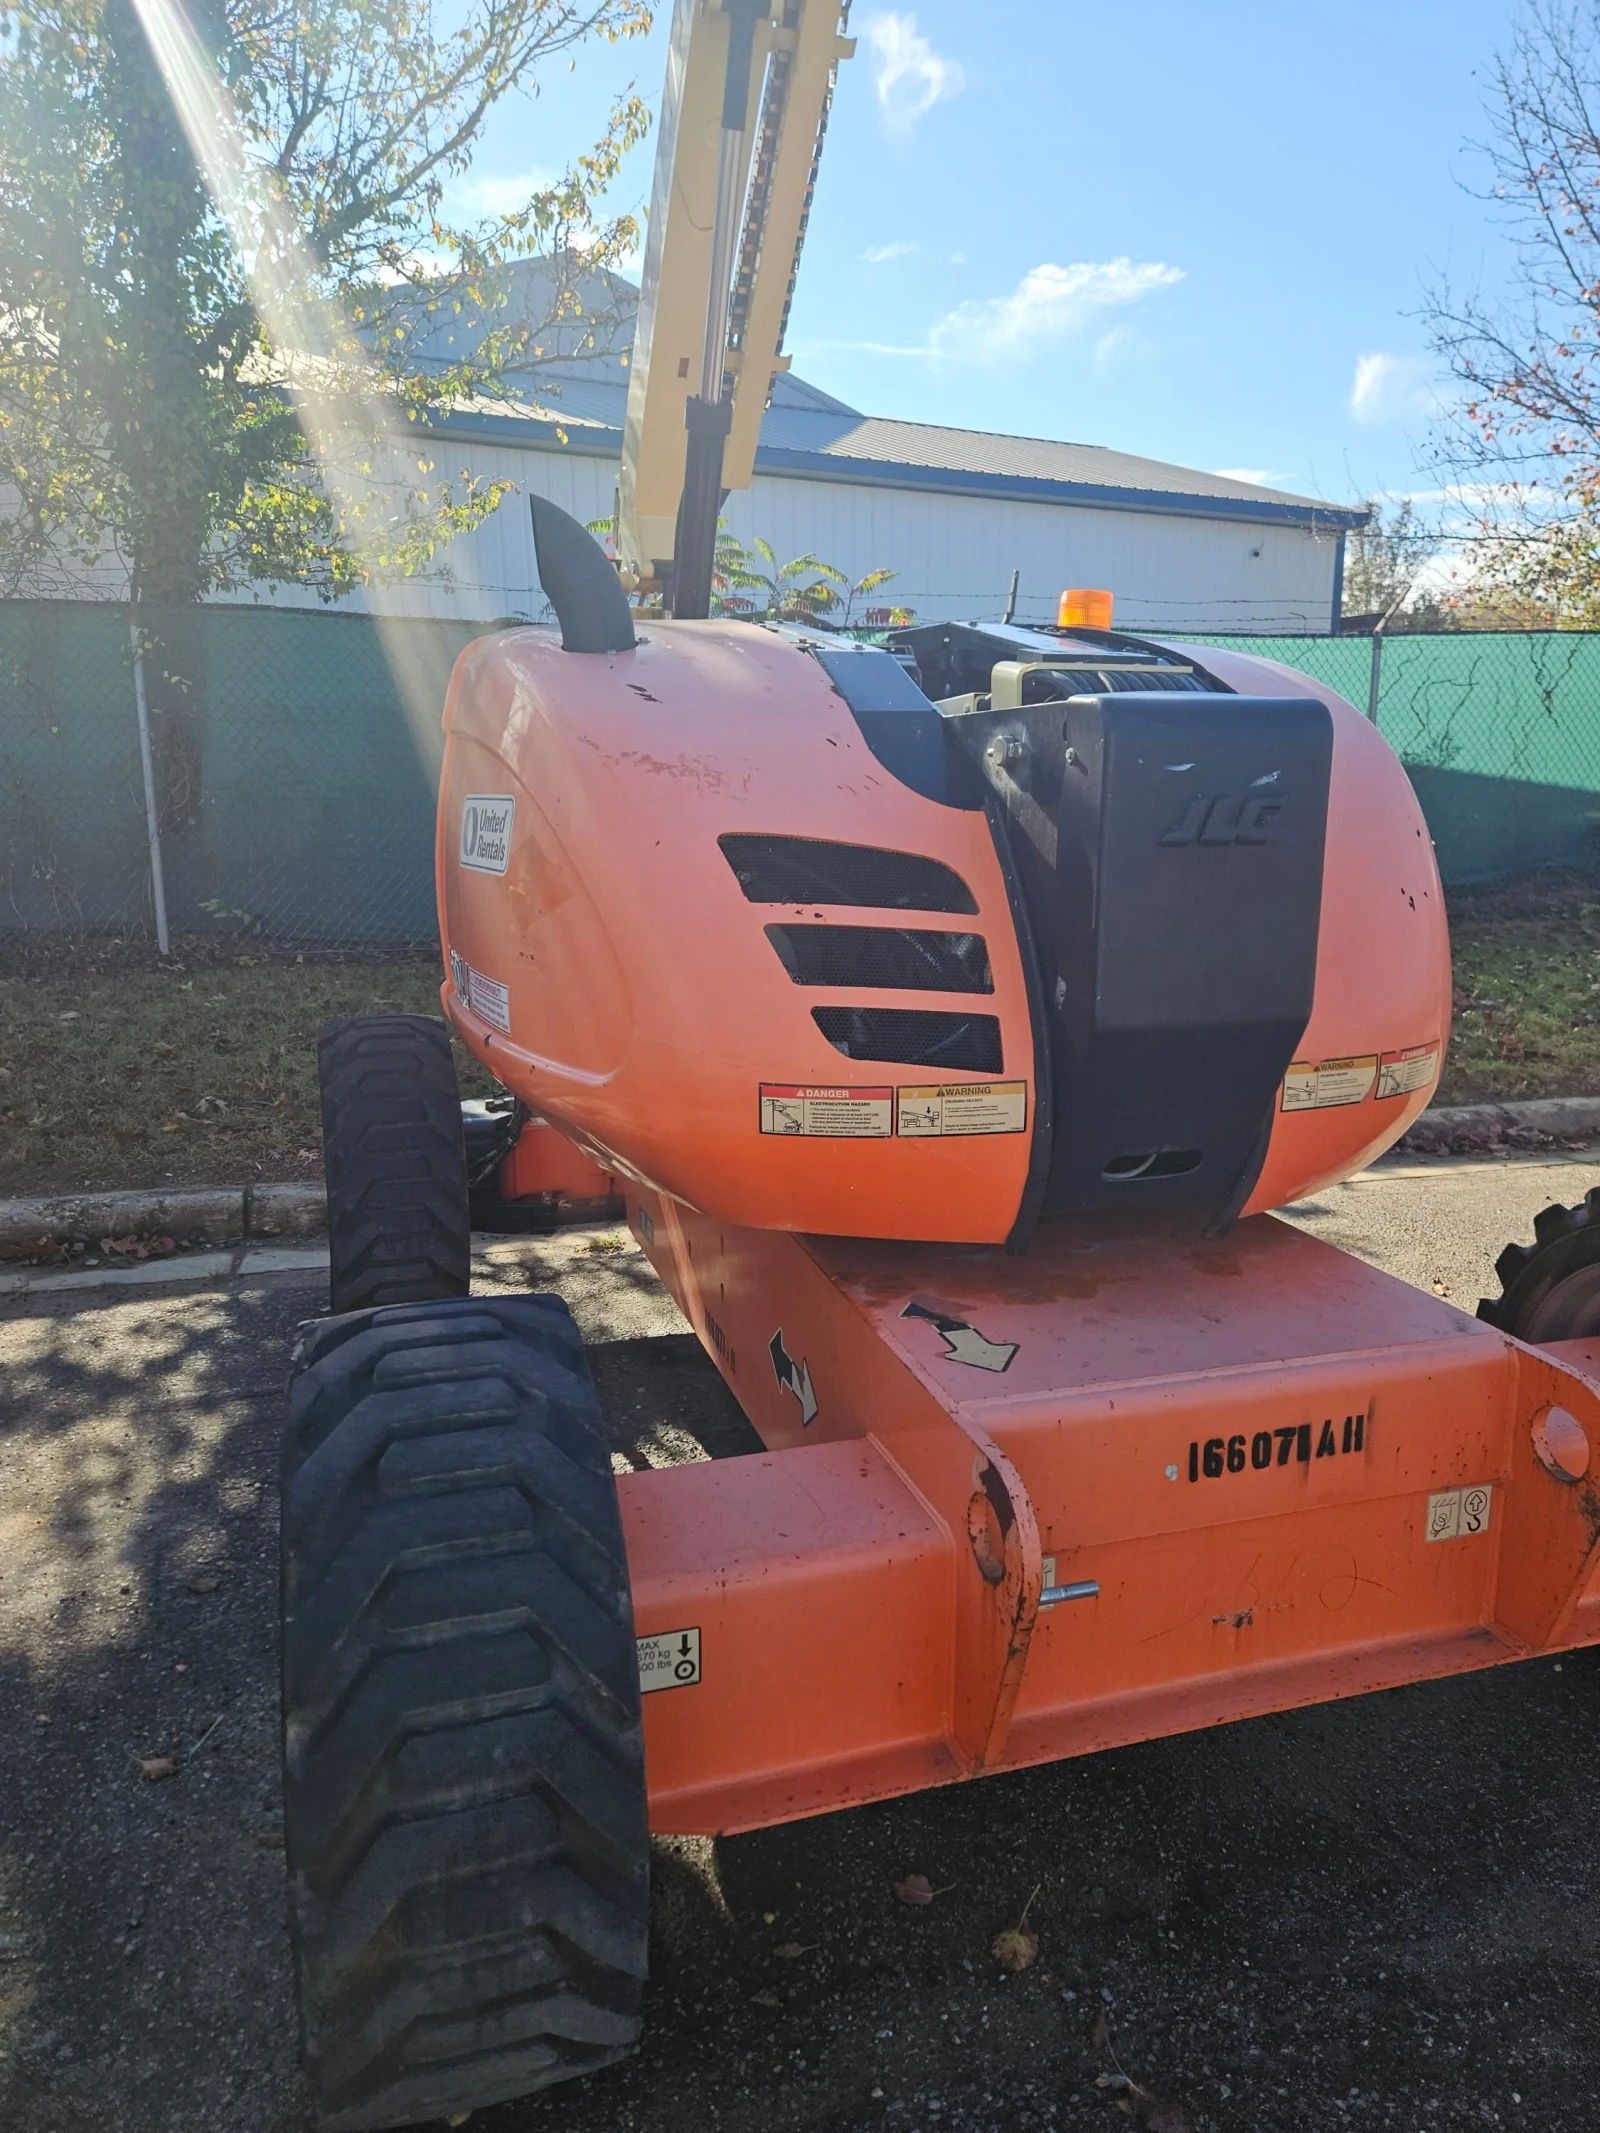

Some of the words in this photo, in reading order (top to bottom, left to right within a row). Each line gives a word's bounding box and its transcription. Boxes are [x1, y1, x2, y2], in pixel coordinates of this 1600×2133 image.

[479, 809, 508, 834] United
[1157, 793, 1288, 848] JLG
[476, 834, 506, 861] Rentals
[1320, 1060, 1355, 1071] WARNING
[806, 1089, 850, 1098] DANGER
[945, 1086, 992, 1096] WARNING
[658, 1649, 671, 1660] kg
[638, 1661, 655, 1673] 00
[657, 1660, 672, 1670] lbs
